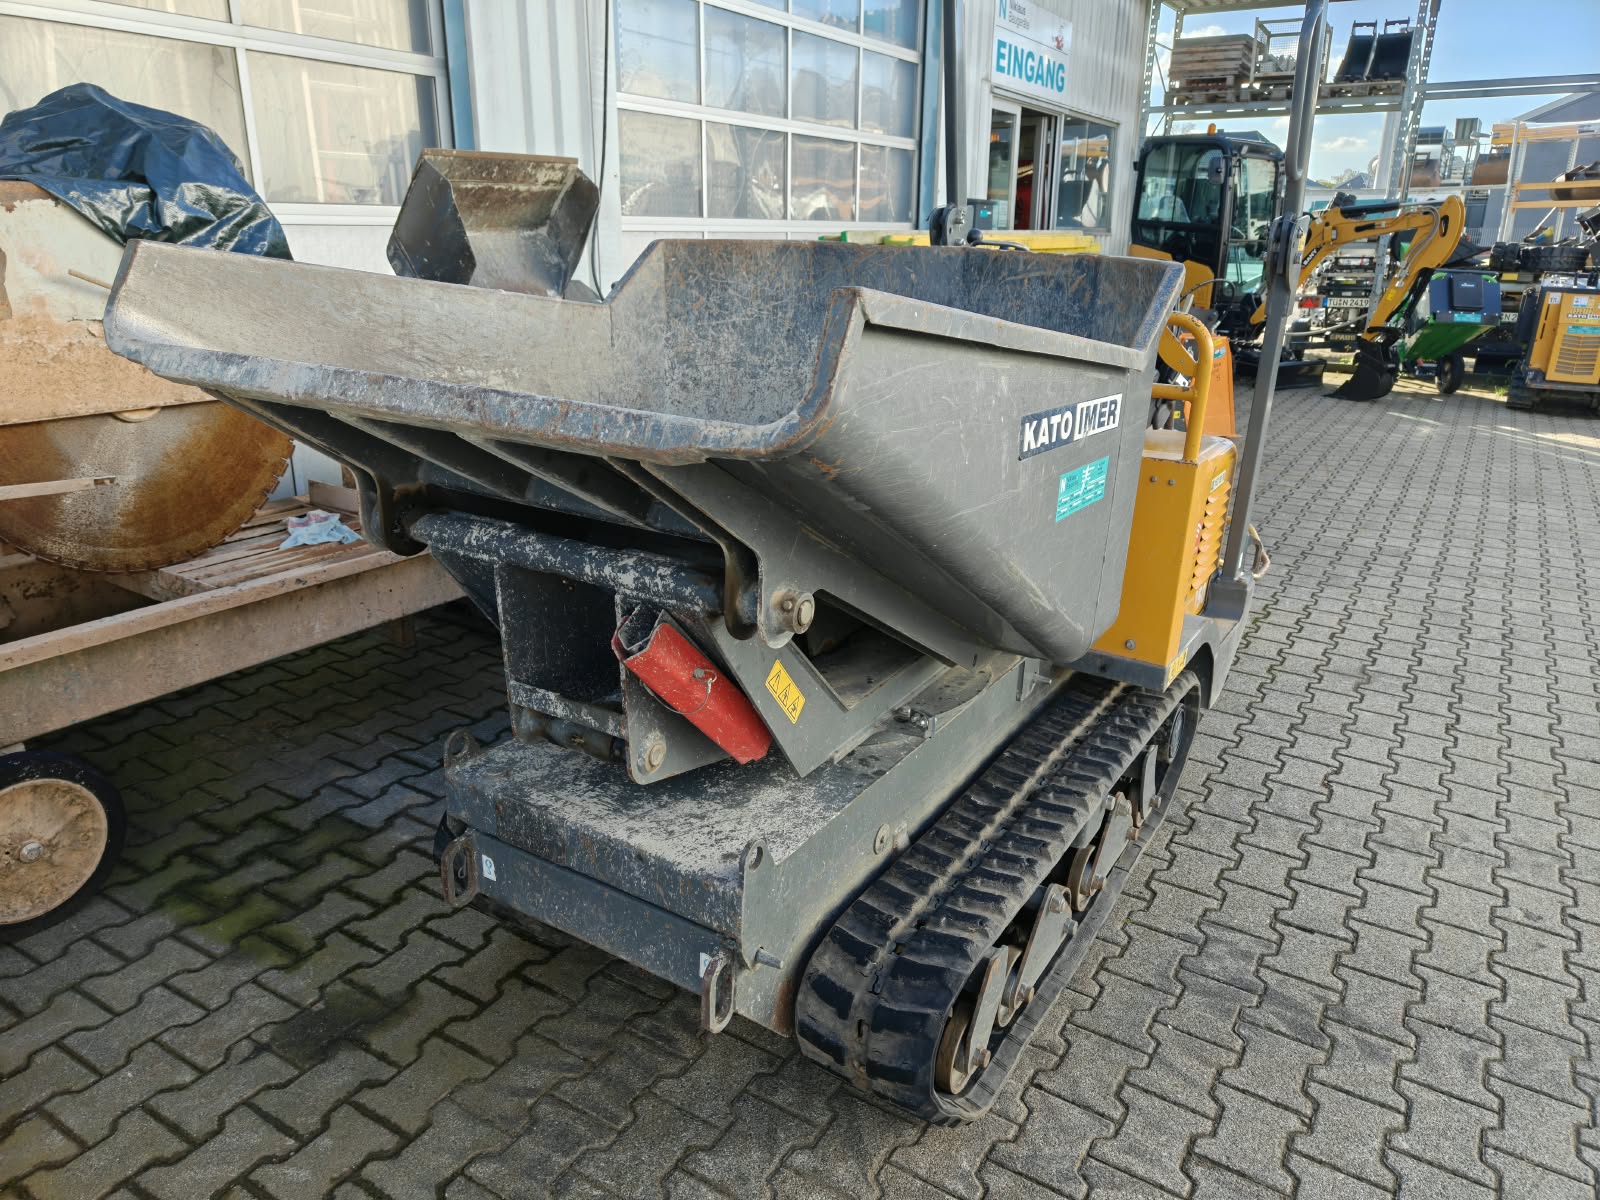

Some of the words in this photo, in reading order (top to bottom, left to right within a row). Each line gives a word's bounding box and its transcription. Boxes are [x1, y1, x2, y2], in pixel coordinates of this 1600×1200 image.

[996, 39, 1065, 93] EINGANG
[1023, 411, 1073, 452] KATO
[1076, 399, 1118, 437] IMER
